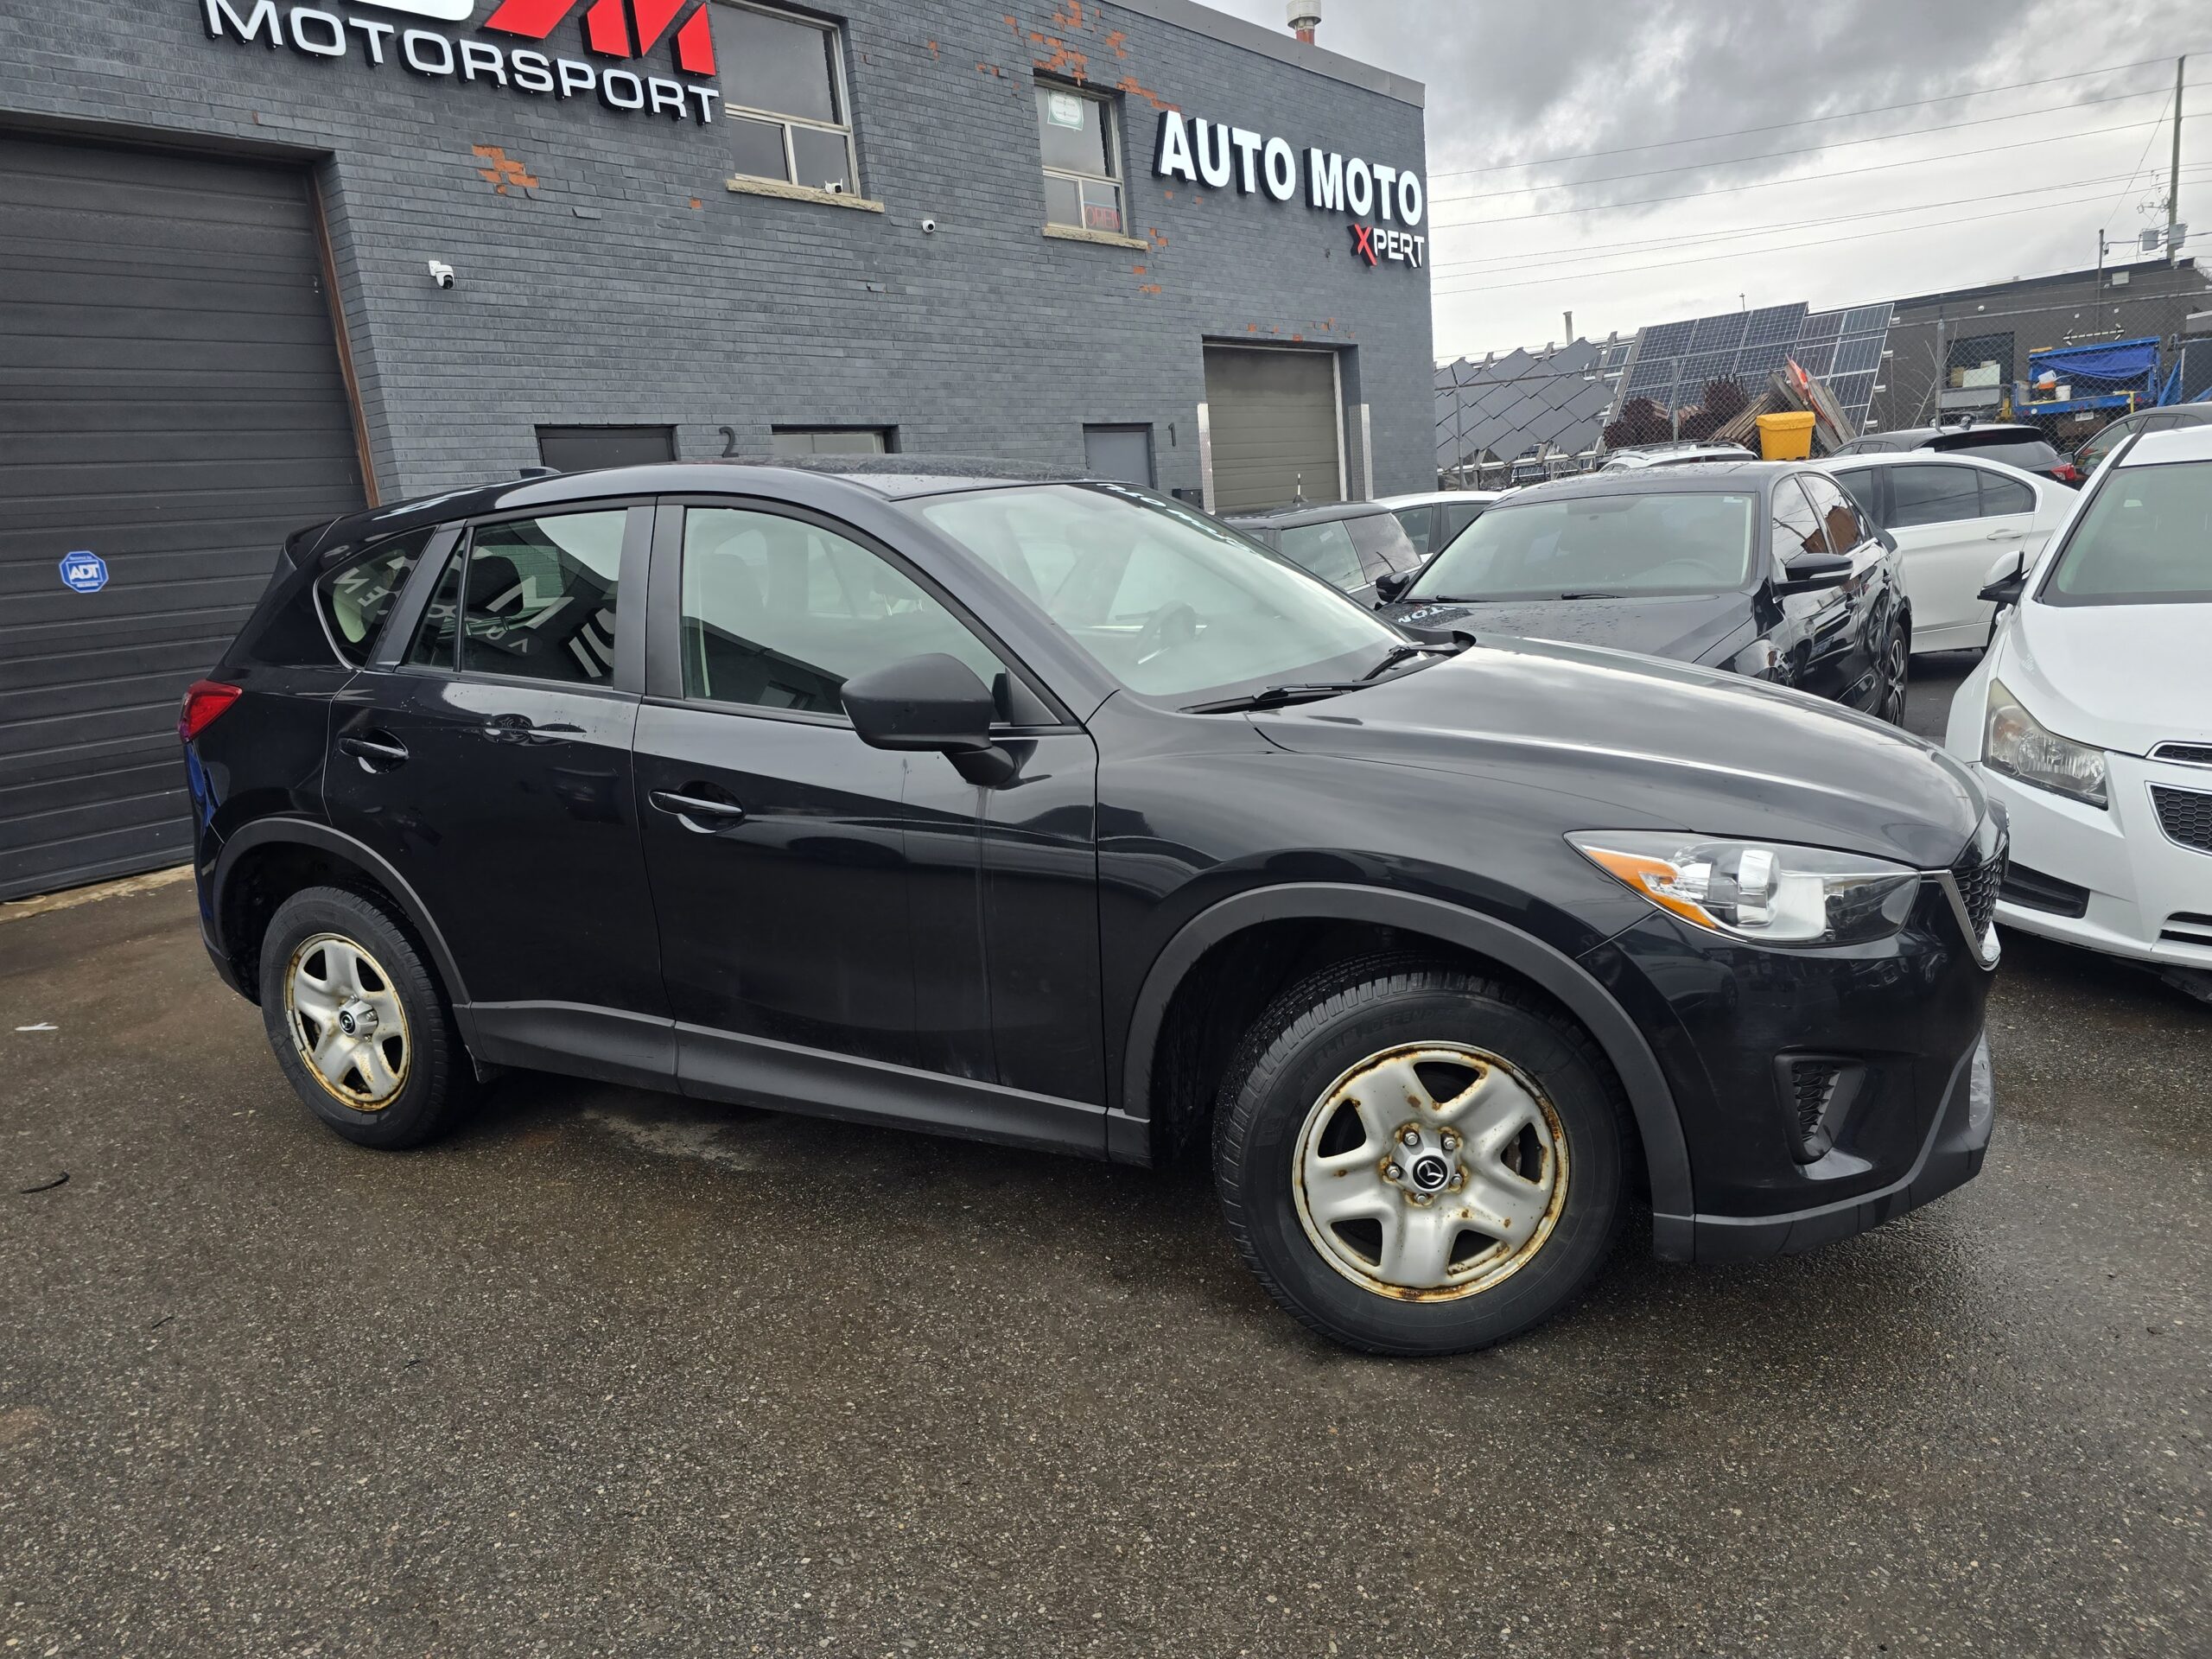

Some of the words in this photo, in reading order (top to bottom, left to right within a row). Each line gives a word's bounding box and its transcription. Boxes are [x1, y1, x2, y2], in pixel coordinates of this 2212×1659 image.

[207, 0, 720, 124] MOTORSPORT
[1160, 110, 1296, 201] AUTO
[1310, 147, 1423, 226] MOTO
[1085, 206, 1120, 229] OPEN
[1354, 223, 1425, 269] XPERT
[719, 427, 739, 458] 2
[1168, 422, 1176, 447] 1
[70, 563, 99, 580] ADT
